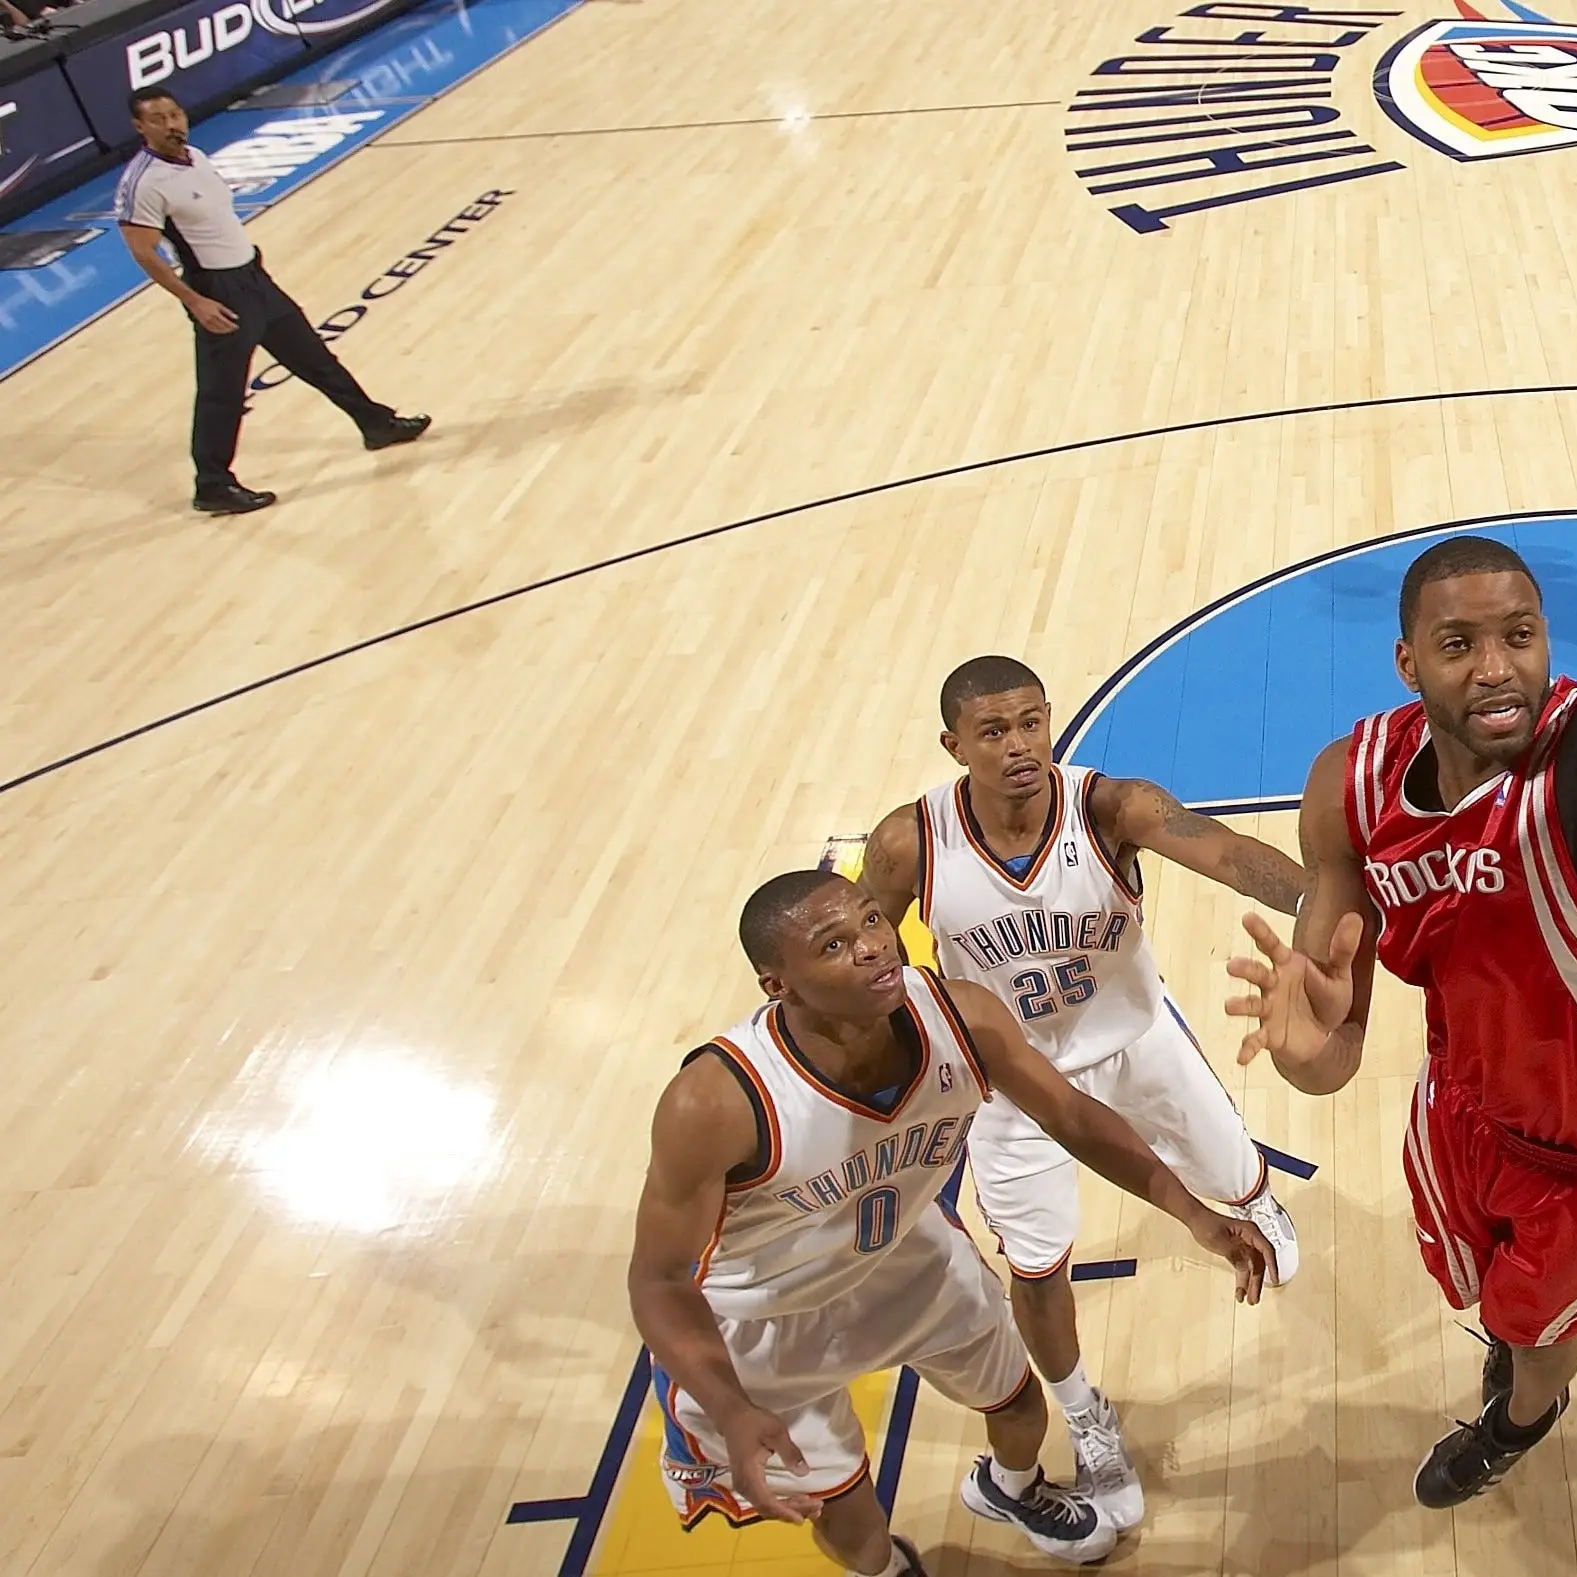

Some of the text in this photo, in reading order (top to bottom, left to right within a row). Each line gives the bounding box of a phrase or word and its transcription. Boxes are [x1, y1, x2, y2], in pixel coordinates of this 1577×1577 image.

[125, 3, 252, 90] BUD
[1063, 2, 1408, 234] THUNDER
[361, 189, 517, 300] CENTER
[948, 909, 1130, 972] THUNDER
[1009, 954, 1098, 1023] 25
[854, 1185, 901, 1256] 0
